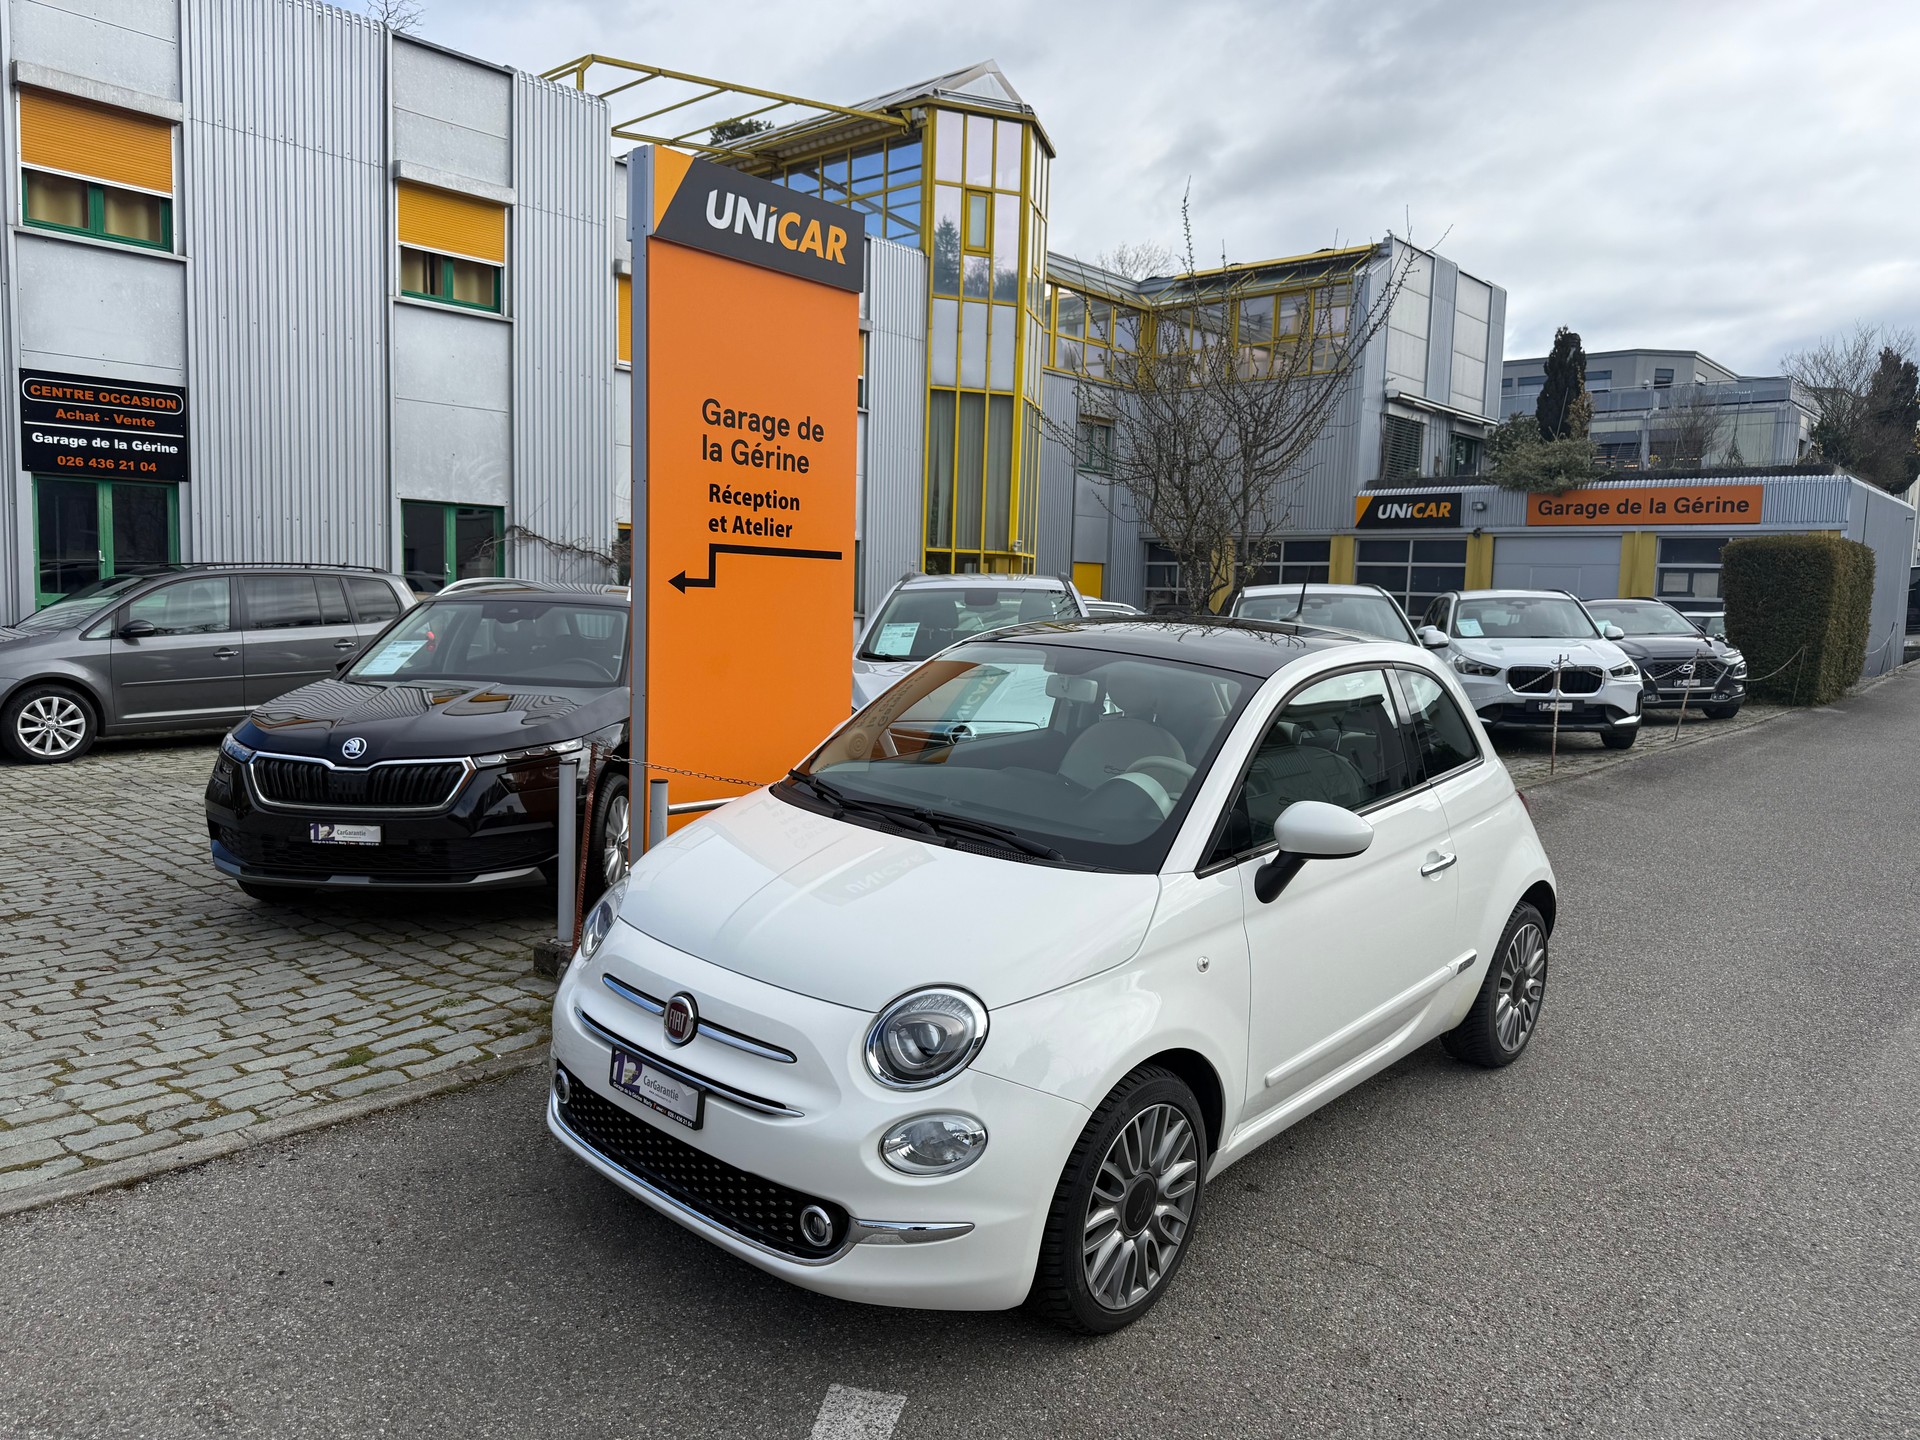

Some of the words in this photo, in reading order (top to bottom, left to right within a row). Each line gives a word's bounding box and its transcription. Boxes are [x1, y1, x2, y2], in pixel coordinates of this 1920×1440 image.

[30, 384, 94, 401] CENTRE
[99, 392, 177, 410] OCCASION
[55, 408, 100, 422] Achat
[113, 413, 156, 427] Vente
[702, 398, 790, 441] Garage
[797, 416, 825, 442] de
[32, 432, 87, 448] Garage
[92, 437, 110, 448] de
[114, 439, 128, 450] la
[132, 439, 178, 454] Gérine
[702, 433, 723, 462] la
[731, 439, 810, 474] Gérine
[57, 455, 84, 467] 026
[88, 457, 115, 469] 436
[119, 460, 135, 471] 21
[140, 461, 157, 472] 04
[709, 483, 800, 512] Réception
[1538, 499, 1610, 519] Garage
[1616, 498, 1642, 515] de
[1649, 497, 1667, 514] la
[1673, 495, 1750, 515] Gérine
[708, 515, 728, 533] et
[732, 515, 793, 538] Atelier
[310, 823, 335, 841] 12
[668, 1008, 687, 1033] FIAT
[614, 1052, 643, 1095] 12
[643, 1075, 679, 1101] CarGarantie
